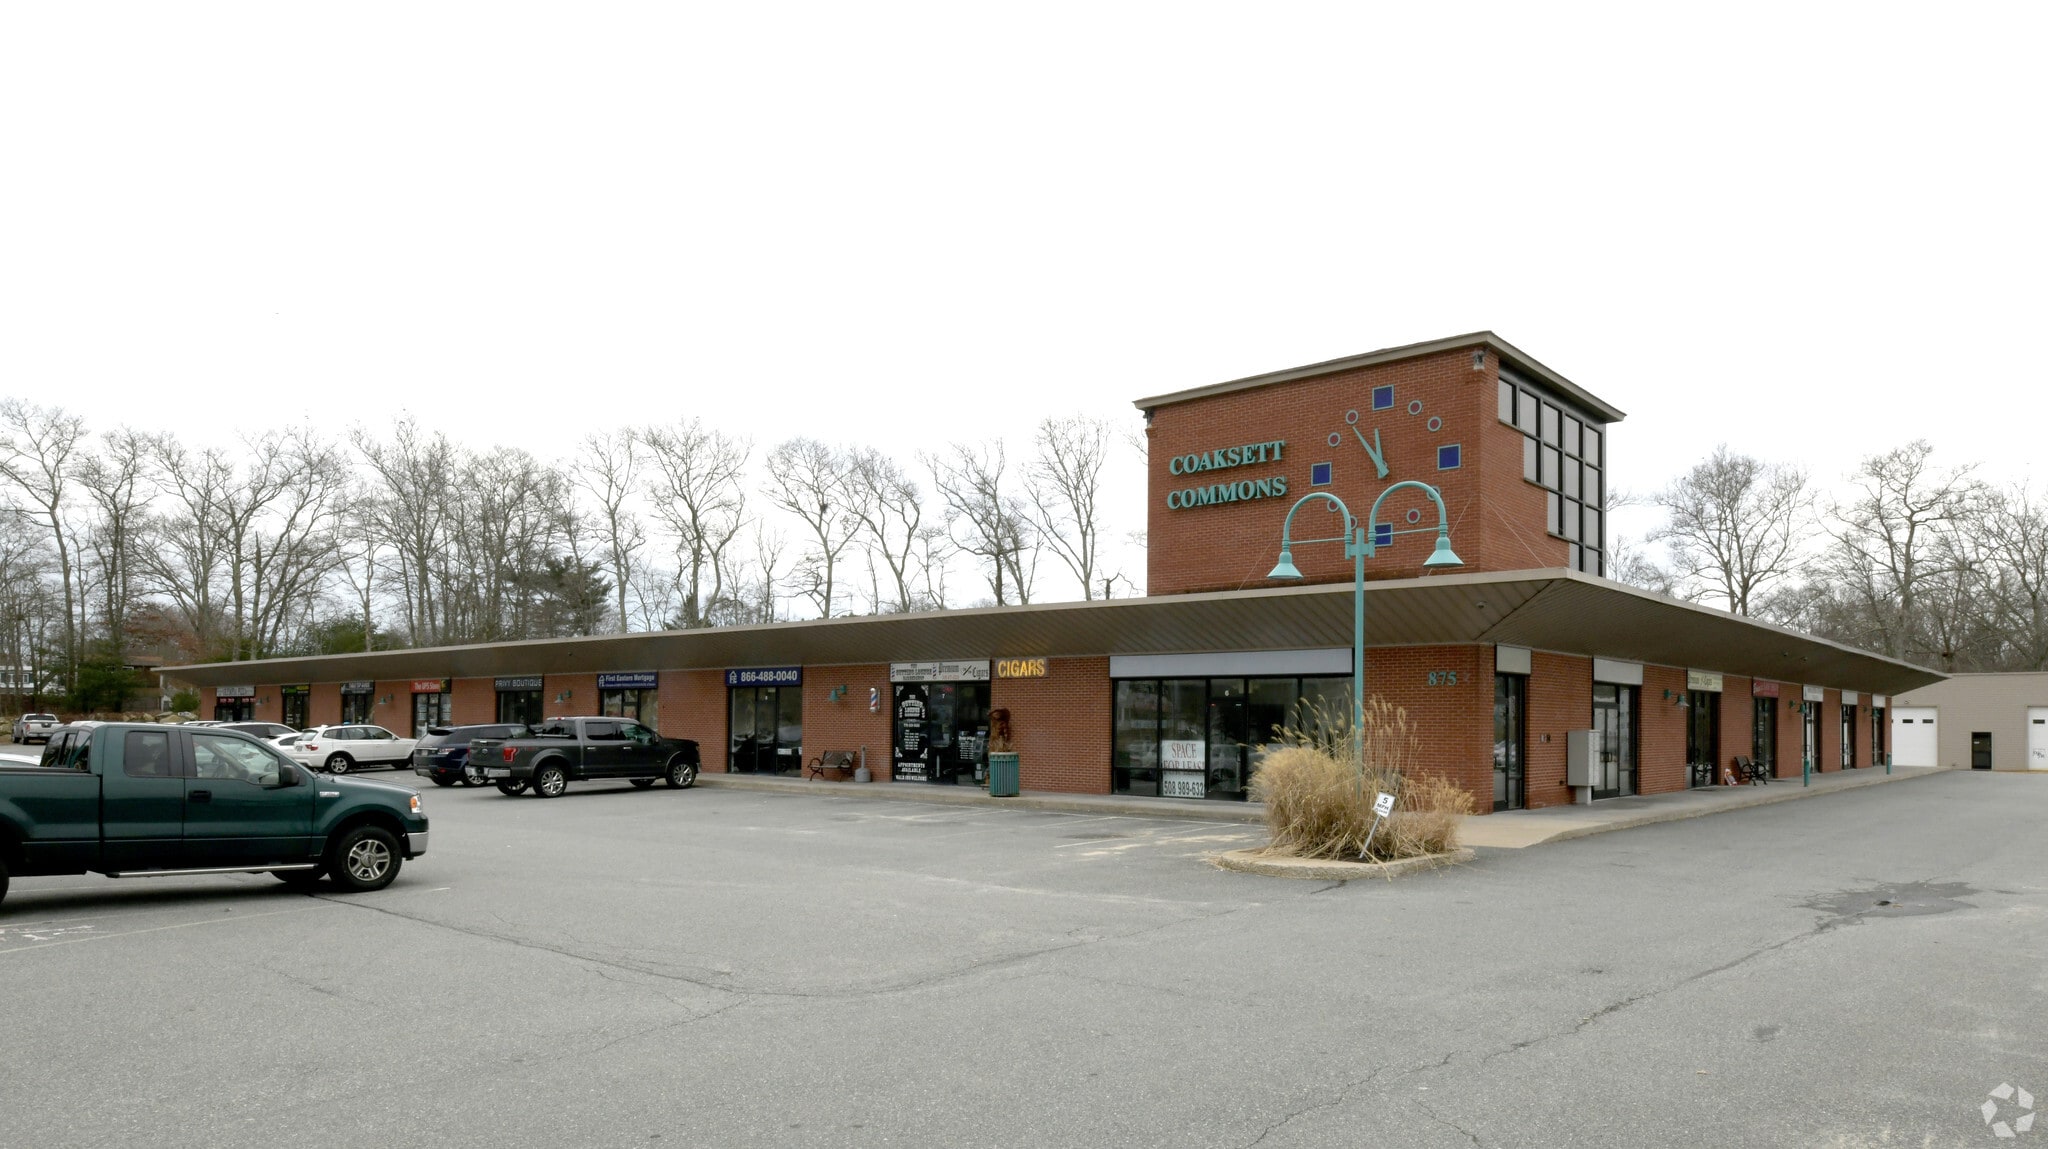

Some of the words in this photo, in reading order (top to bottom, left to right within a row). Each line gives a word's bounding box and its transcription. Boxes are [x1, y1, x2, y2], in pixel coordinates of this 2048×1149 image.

[1169, 439, 1287, 476] COAKSETT
[1167, 475, 1288, 510] COMMONS
[998, 659, 1045, 677] CIGARS
[495, 679, 511, 688] PRIVY
[512, 677, 543, 688] BOUTIQUE
[634, 673, 655, 682] Mortgage
[741, 671, 798, 682] 866-488-0040
[1428, 671, 1457, 686] 875
[1172, 743, 1197, 758] SPACE
[1164, 780, 1176, 795] 508
[1376, 803, 1390, 811] MPH
[1382, 796, 1389, 804] 5
